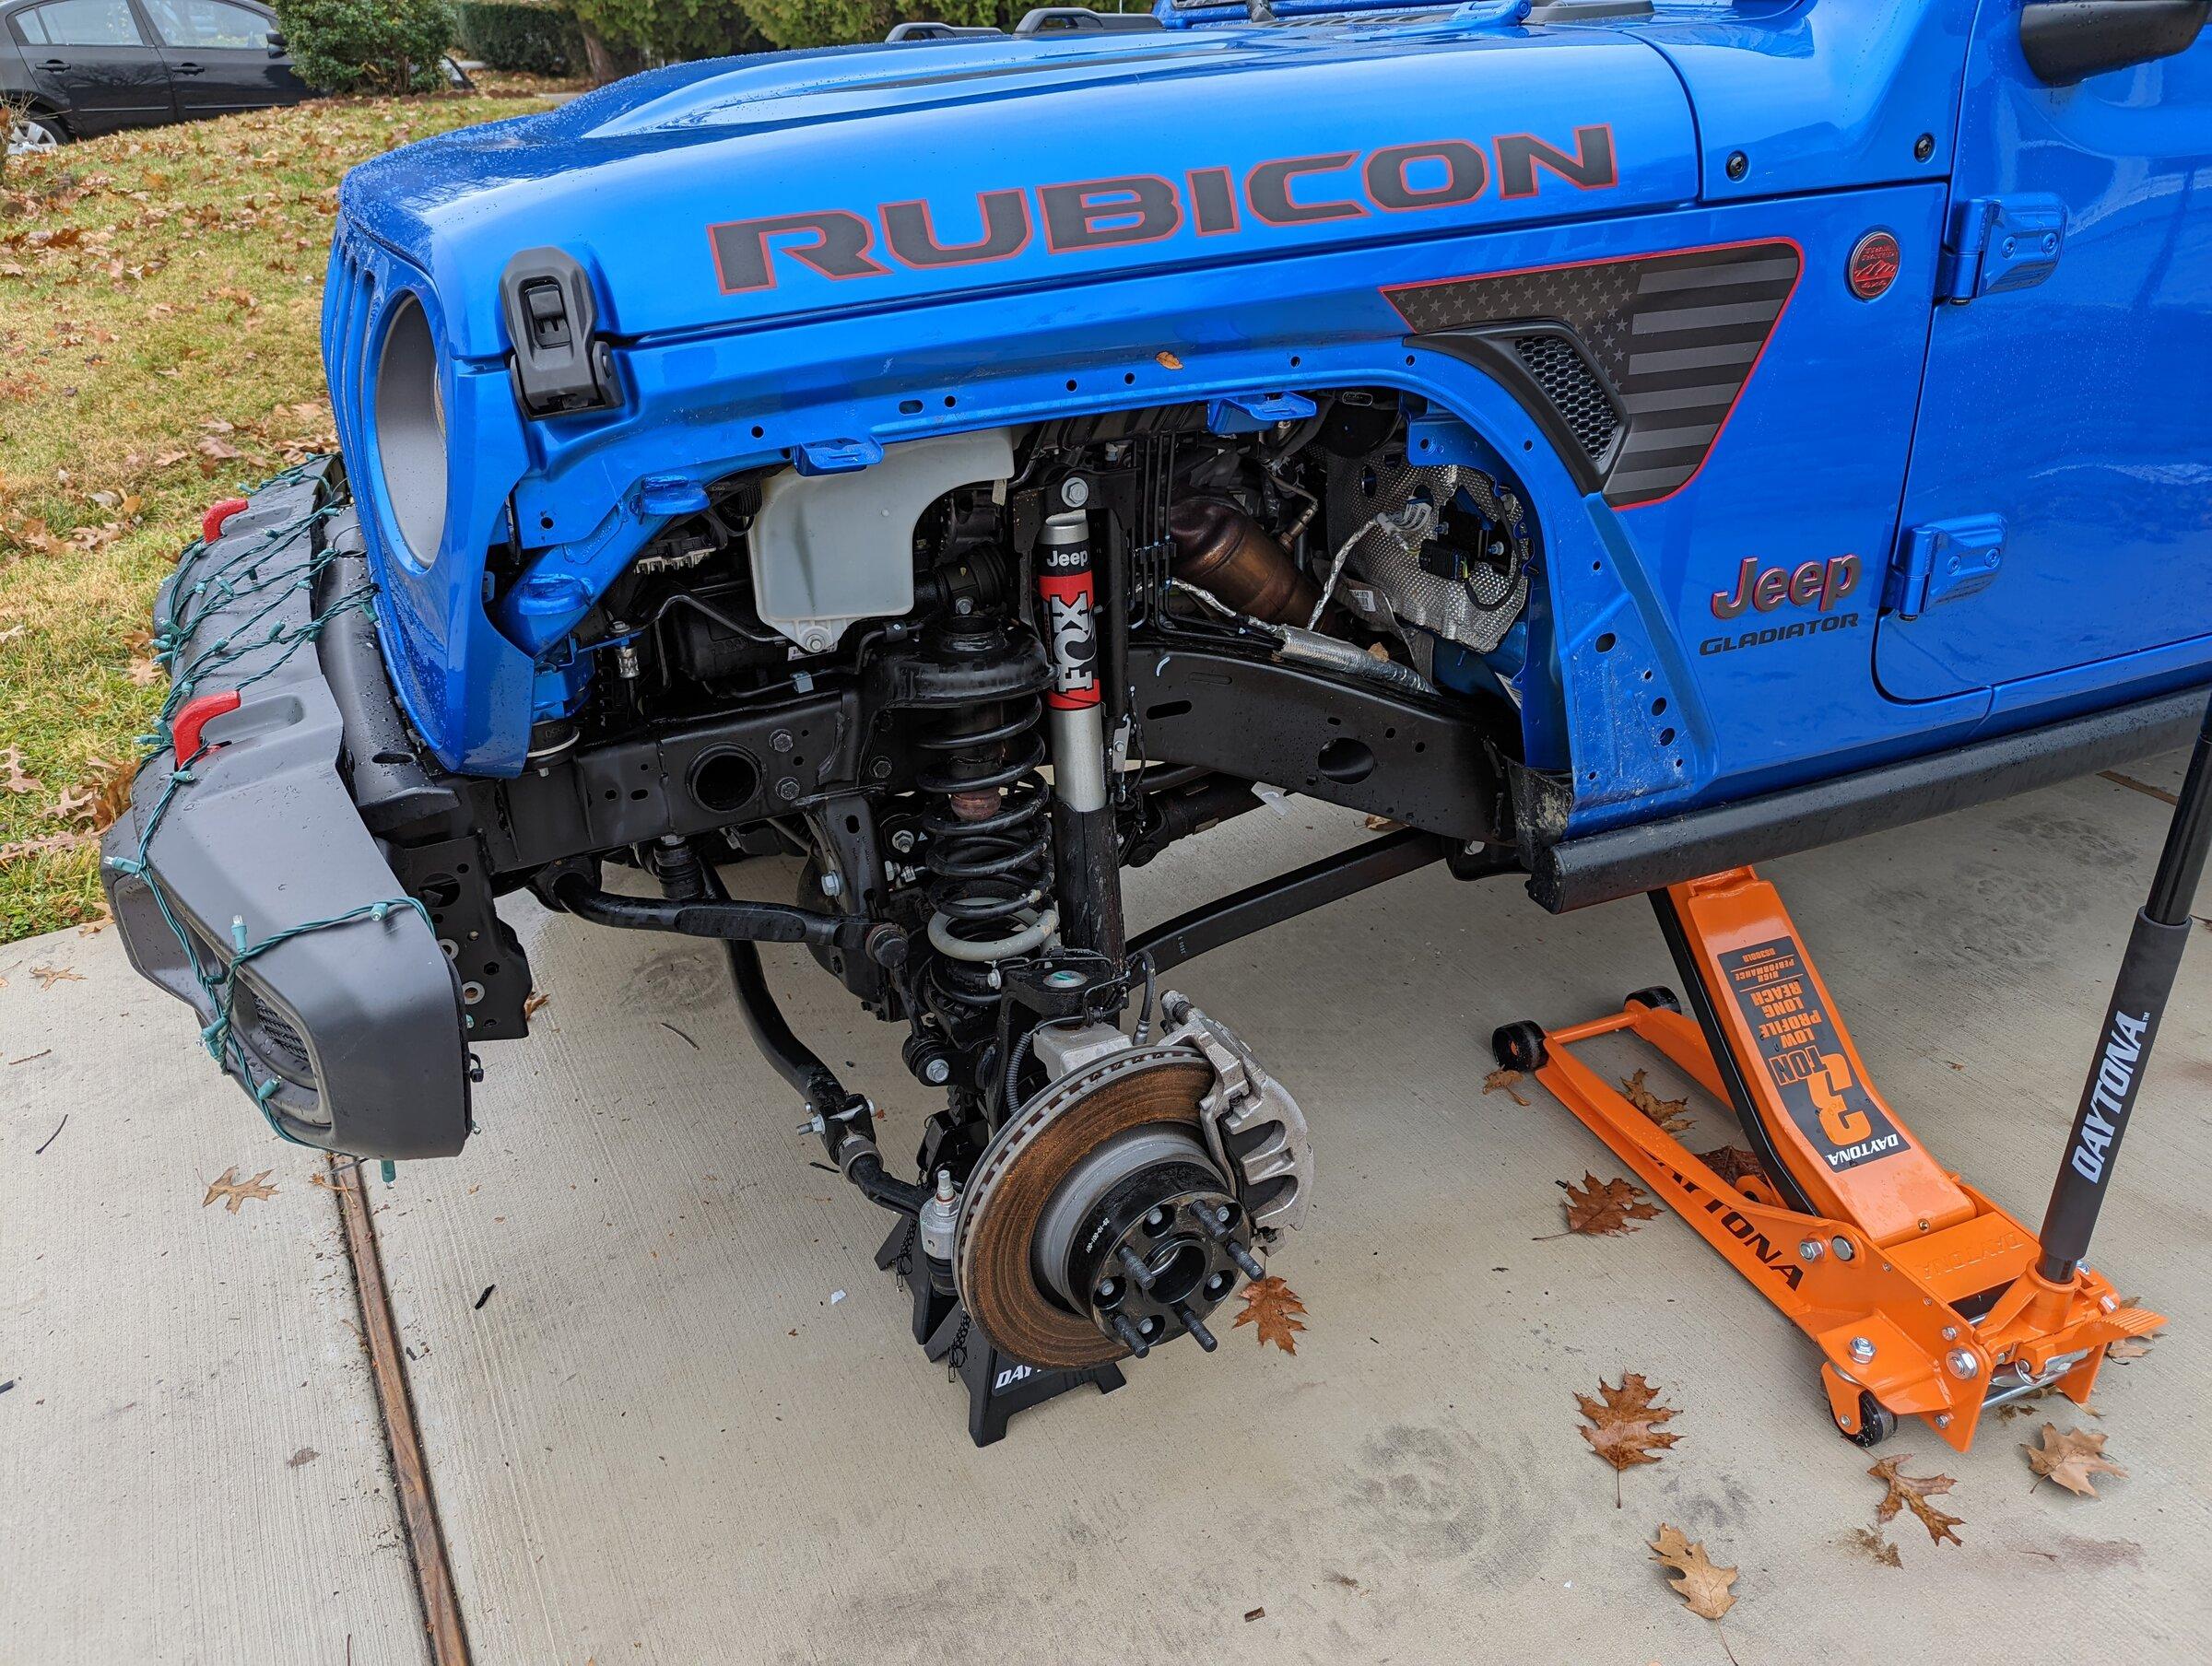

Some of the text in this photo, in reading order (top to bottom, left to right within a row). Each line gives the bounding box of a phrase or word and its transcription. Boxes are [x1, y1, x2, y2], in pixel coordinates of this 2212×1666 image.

[706, 123, 1618, 295] RUBICON
[1047, 550, 1088, 567] Jeep
[1711, 554, 1861, 619] Jeep
[1051, 592, 1097, 694] FOX
[1700, 613, 1859, 656] GLADIATOR
[1735, 959, 1794, 981] PERFORMANCE
[1758, 970, 1779, 982] HIGH
[1750, 981, 1803, 1006] REACH
[1764, 997, 1805, 1018] LONG
[1759, 1010, 1822, 1038] PROFILE
[1780, 1027, 1815, 1049] LOW
[1769, 1046, 1828, 1086] TON
[1806, 1053, 1872, 1146] 3
[2072, 1010, 2147, 1184] DAYTONA
[1825, 1133, 1899, 1167] DAYTONA
